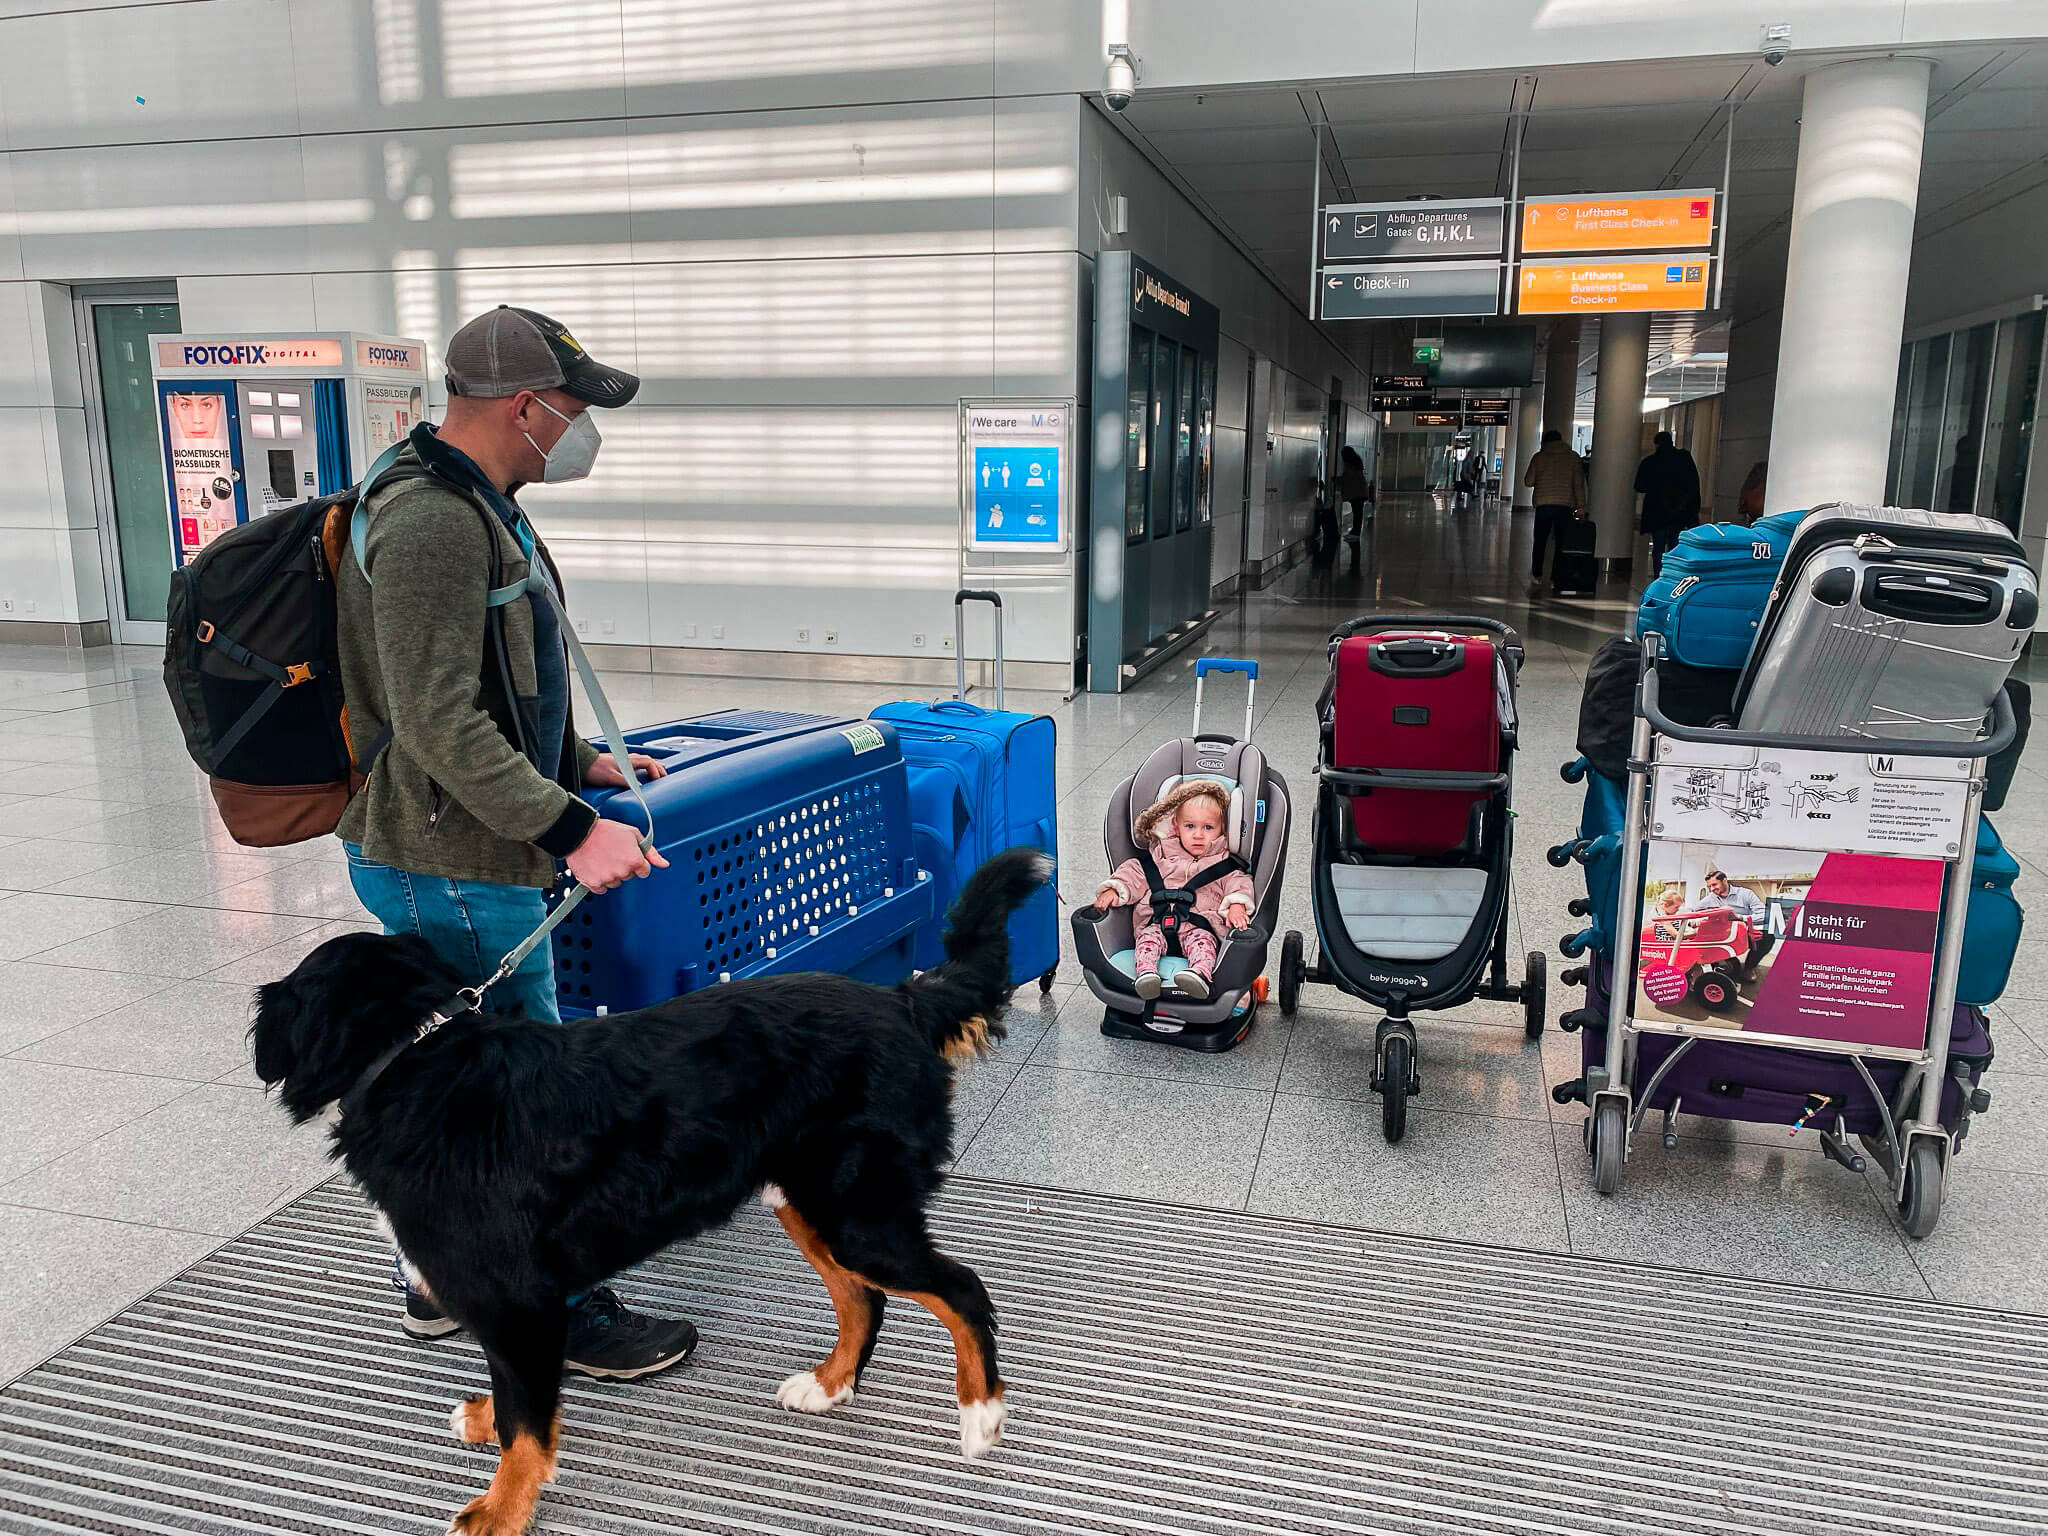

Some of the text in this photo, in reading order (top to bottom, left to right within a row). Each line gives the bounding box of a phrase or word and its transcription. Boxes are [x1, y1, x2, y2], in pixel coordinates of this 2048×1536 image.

[1576, 208, 1629, 218] Lufthansa
[1387, 213, 1468, 225] Abflug Departures
[1600, 219, 1629, 229] Class
[1631, 218, 1679, 228] Check-in
[1387, 227, 1413, 237] Gates
[1572, 271, 1624, 281] Lufthansa
[1353, 275, 1410, 290] Check-in
[1619, 282, 1649, 291] Class
[1571, 295, 1617, 305] Check-in
[367, 388, 409, 399] PASSBILDER
[995, 418, 1017, 428] care
[1032, 415, 1044, 427] M
[174, 449, 230, 458] BIOMETRISCHE
[175, 460, 221, 469] PASSBILDER
[1200, 760, 1225, 769] GRACO
[1877, 757, 1894, 772] M
[1752, 799, 1760, 808] M
[1808, 914, 1844, 928] steht
[1846, 916, 1867, 929] für
[1807, 928, 1843, 941] Minis
[1641, 949, 1667, 961] minipilot
[1803, 962, 1896, 979] Faszination für die ganze
[1370, 973, 1418, 986] baby jogger
[1803, 971, 1893, 987] Familie im Besucherpark
[1816, 981, 1853, 991] Flughafen
[1854, 985, 1888, 995] München
[1799, 1008, 1830, 1017] Verbindung
